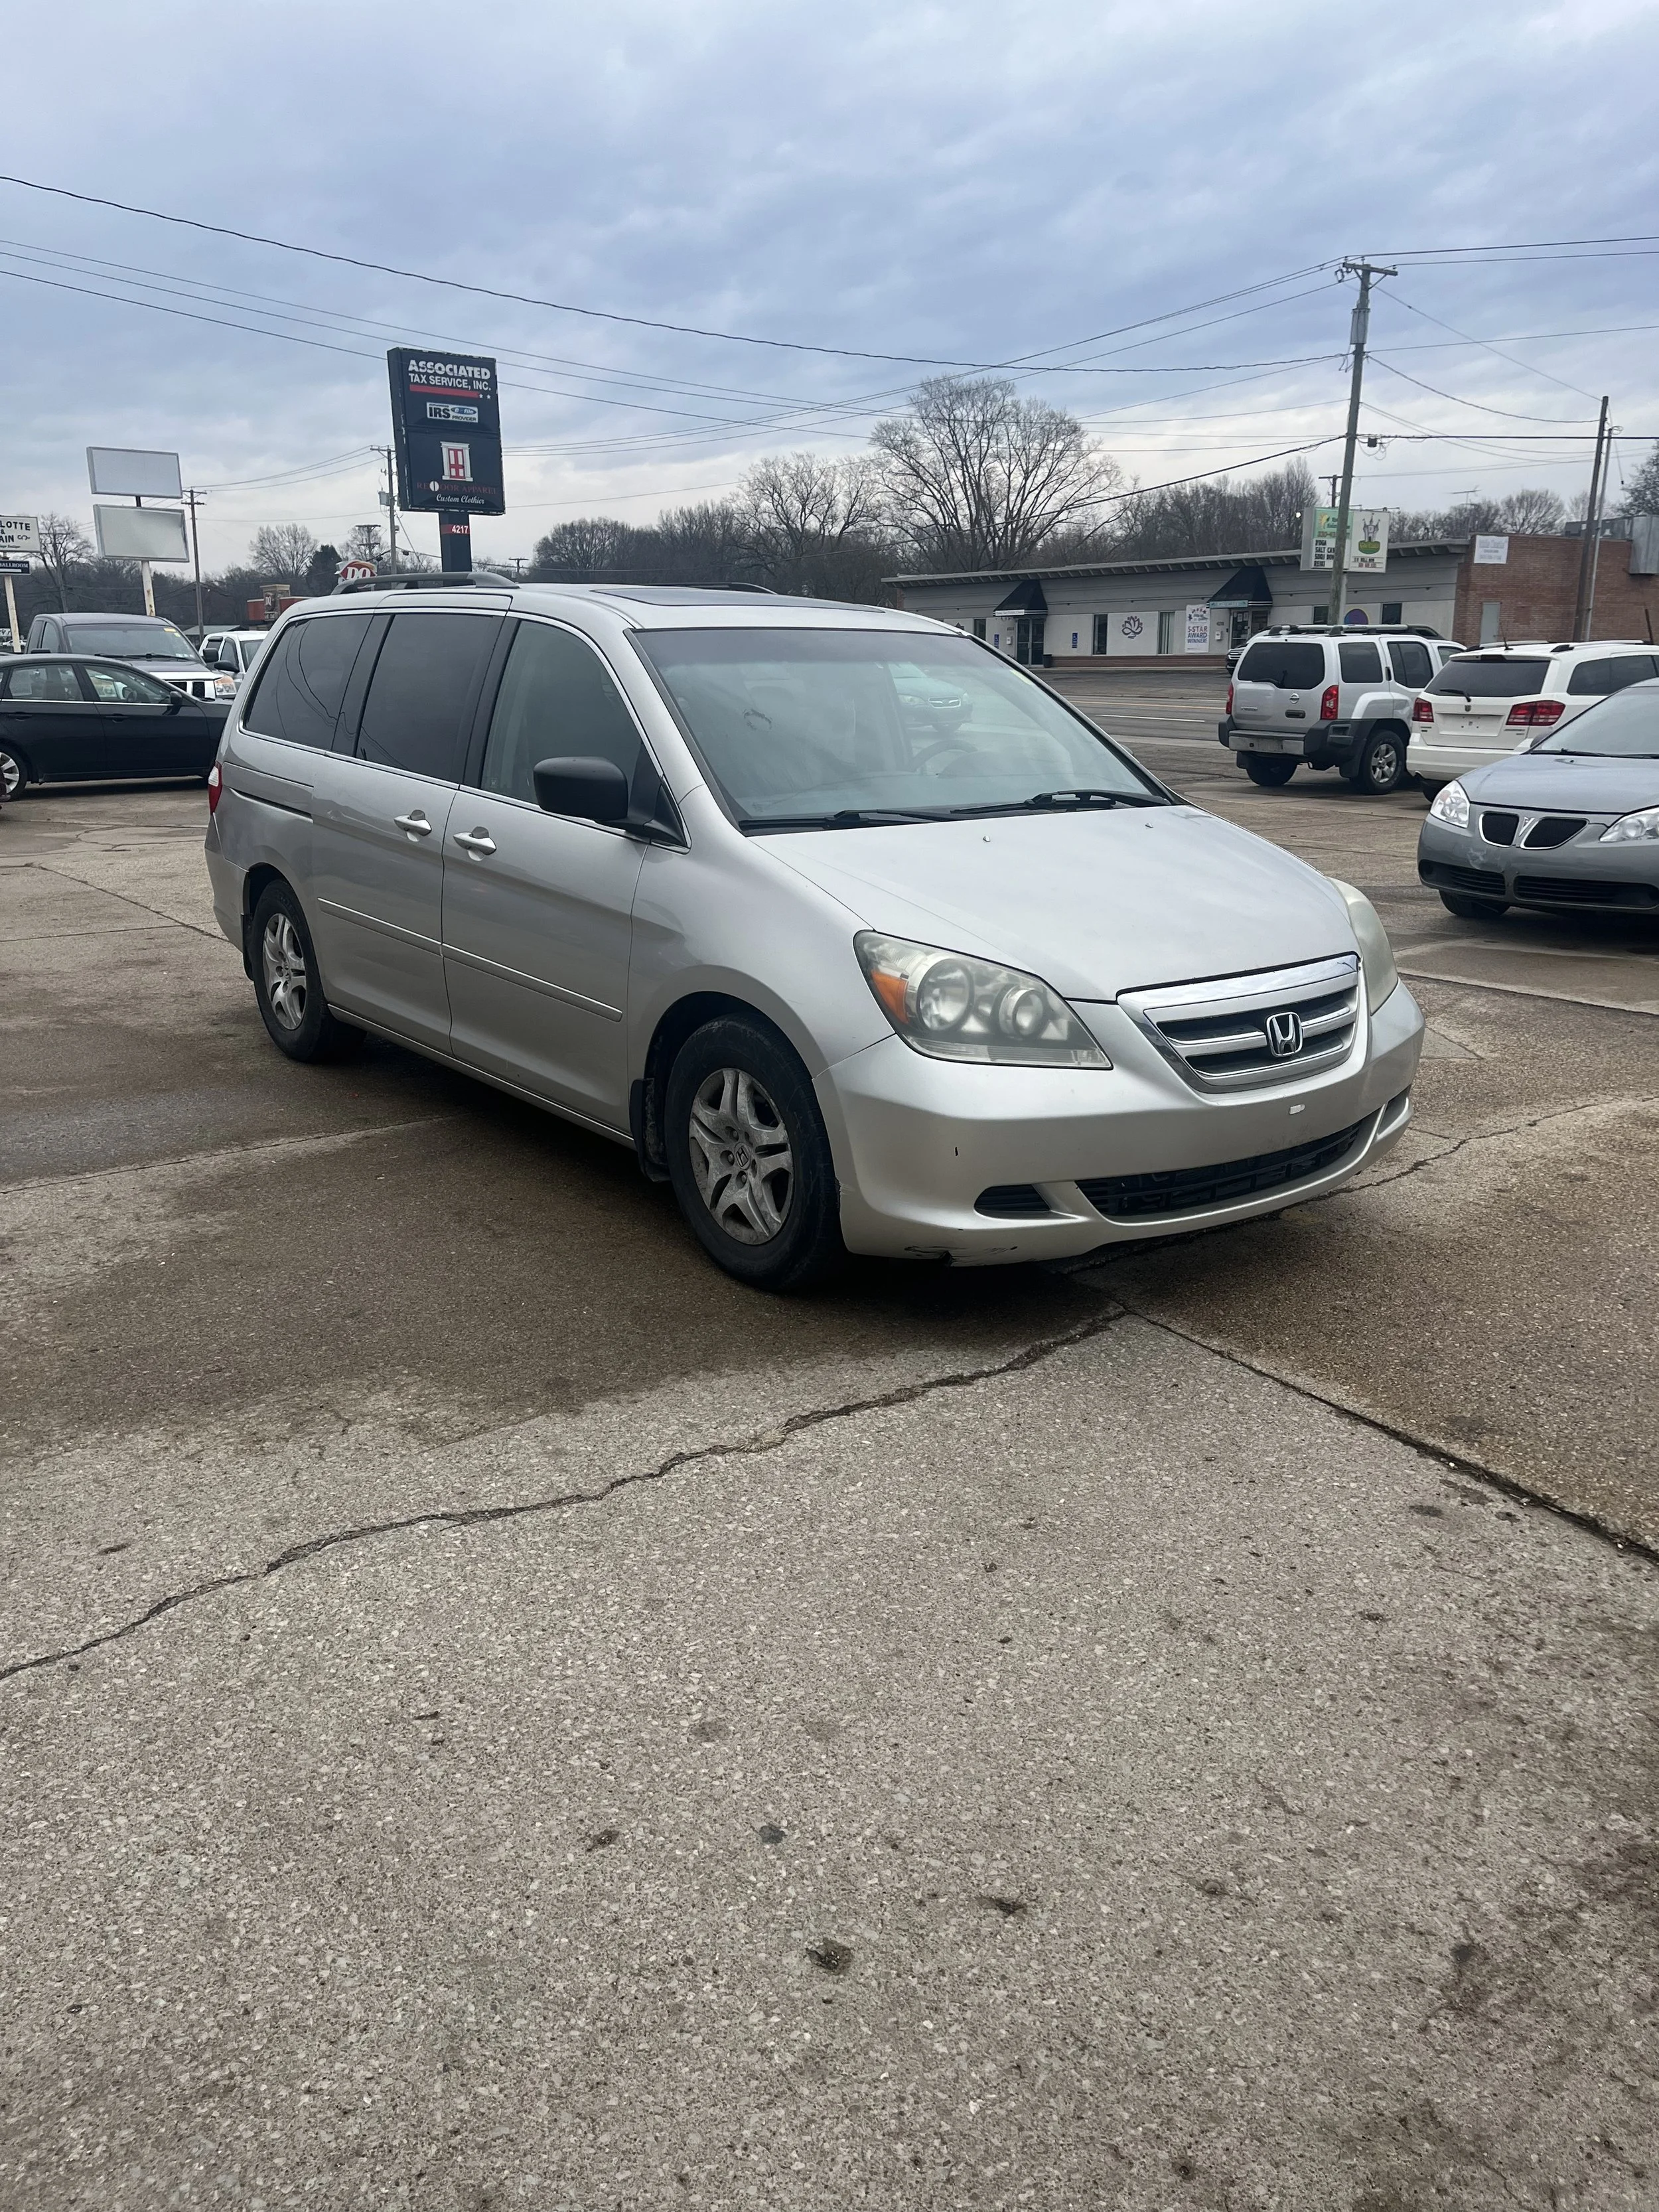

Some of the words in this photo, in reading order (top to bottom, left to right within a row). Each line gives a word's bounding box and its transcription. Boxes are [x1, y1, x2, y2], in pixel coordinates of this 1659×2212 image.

[408, 360, 490, 380] ASSOCIATED
[409, 373, 427, 384] TAX
[429, 375, 471, 390] SERVICE,
[473, 380, 491, 391] INC.
[429, 406, 451, 419] IRS
[436, 494, 459, 502] Custom
[461, 495, 484, 504] Clothier
[452, 525, 469, 534] 4217
